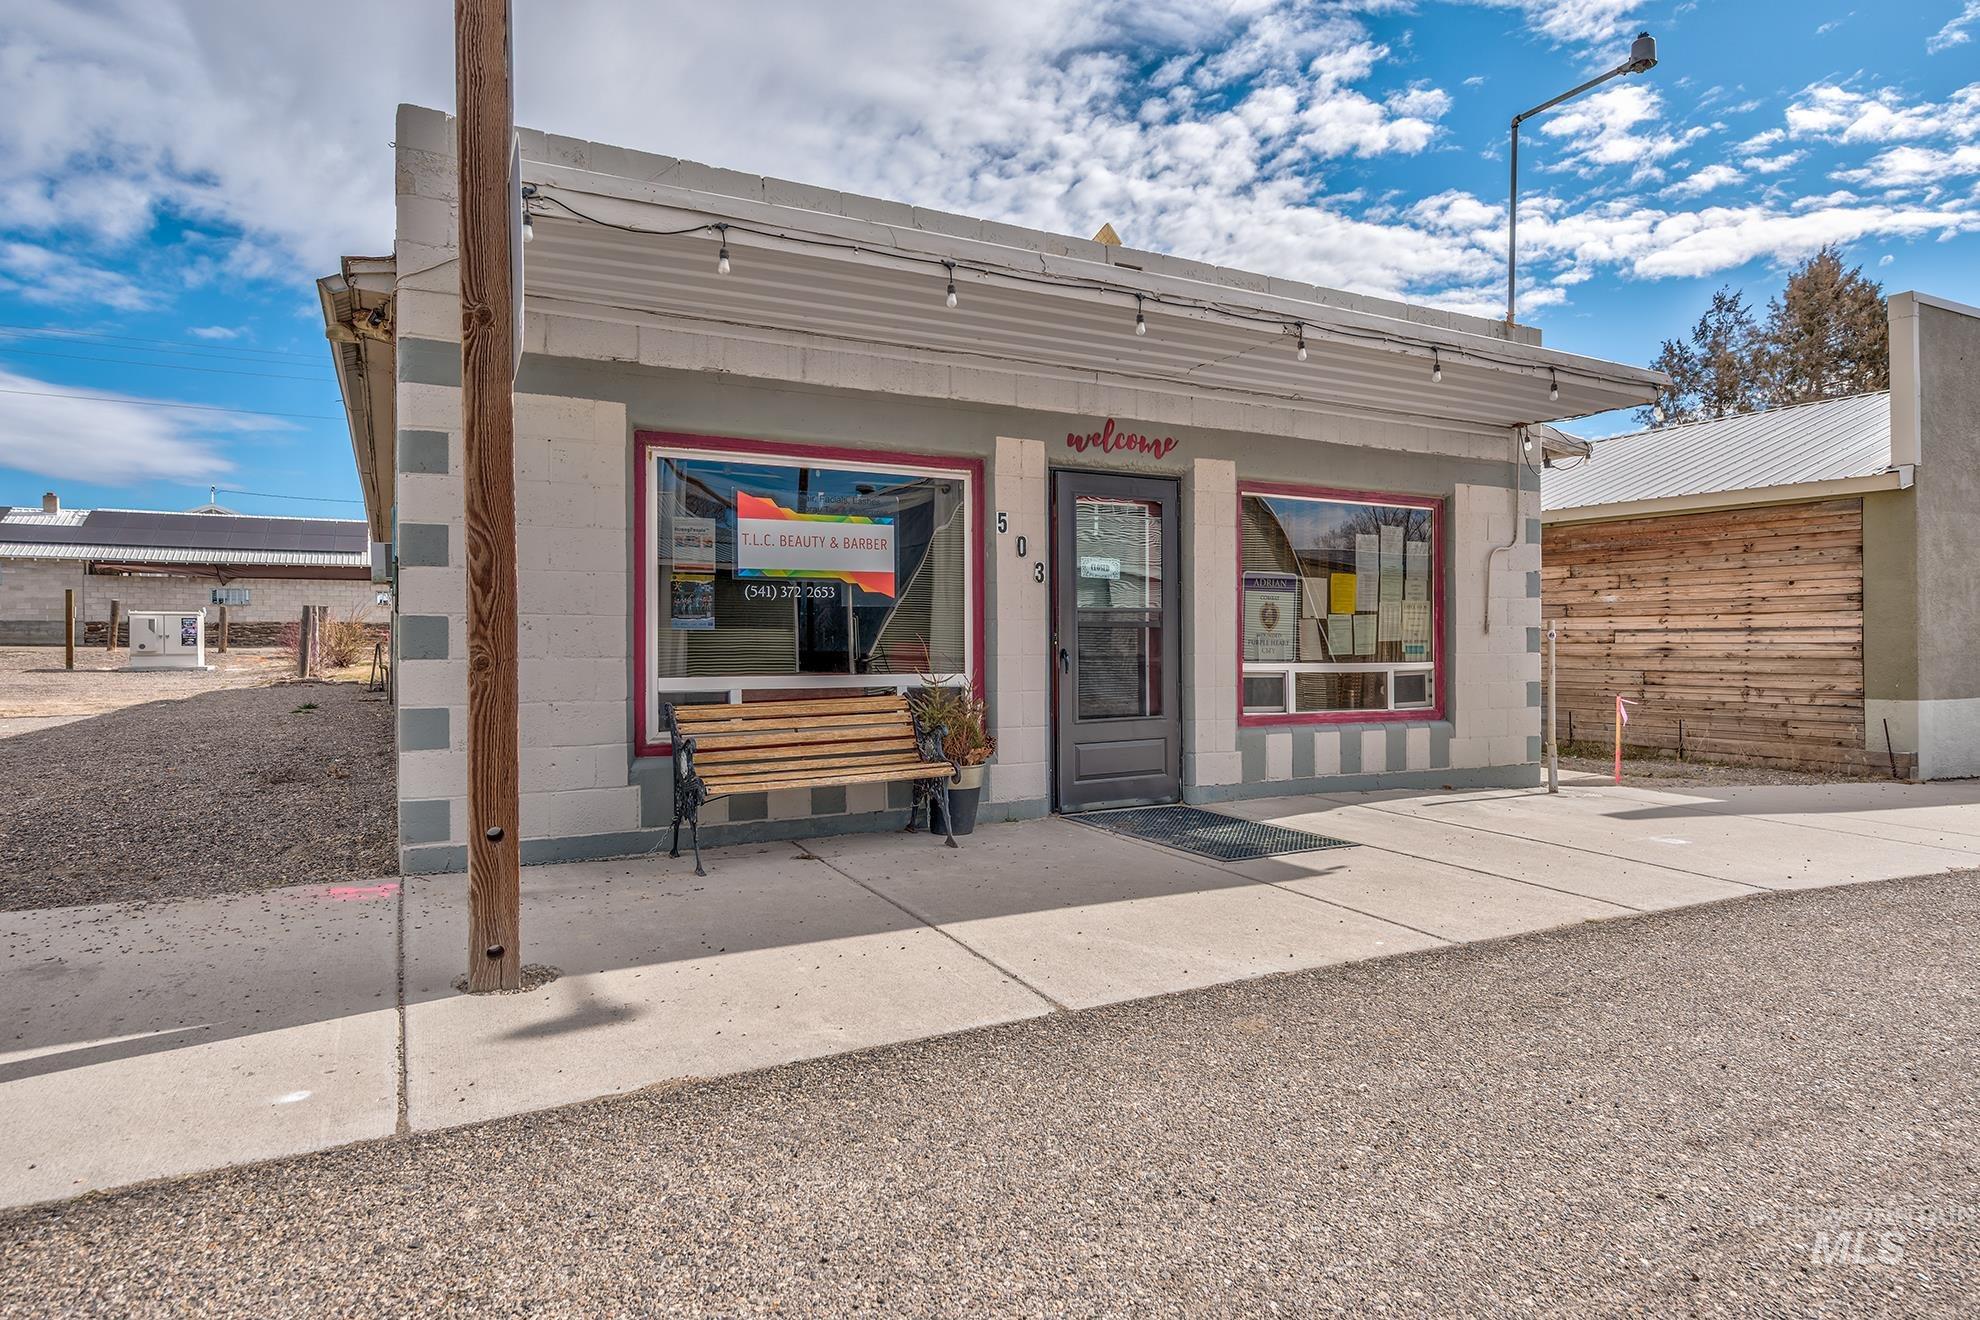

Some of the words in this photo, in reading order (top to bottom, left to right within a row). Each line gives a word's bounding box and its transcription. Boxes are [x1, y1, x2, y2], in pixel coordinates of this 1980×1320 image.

[1065, 417, 1180, 460] welcome
[742, 533, 775, 547] T.L.C.
[779, 534, 826, 549] BEAUTY
[829, 536, 839, 549] &
[843, 536, 888, 551] BARBER
[1253, 578, 1288, 588] ADRIAN
[744, 584, 777, 601] (541)
[780, 585, 802, 598] 372
[806, 586, 835, 599] 2653
